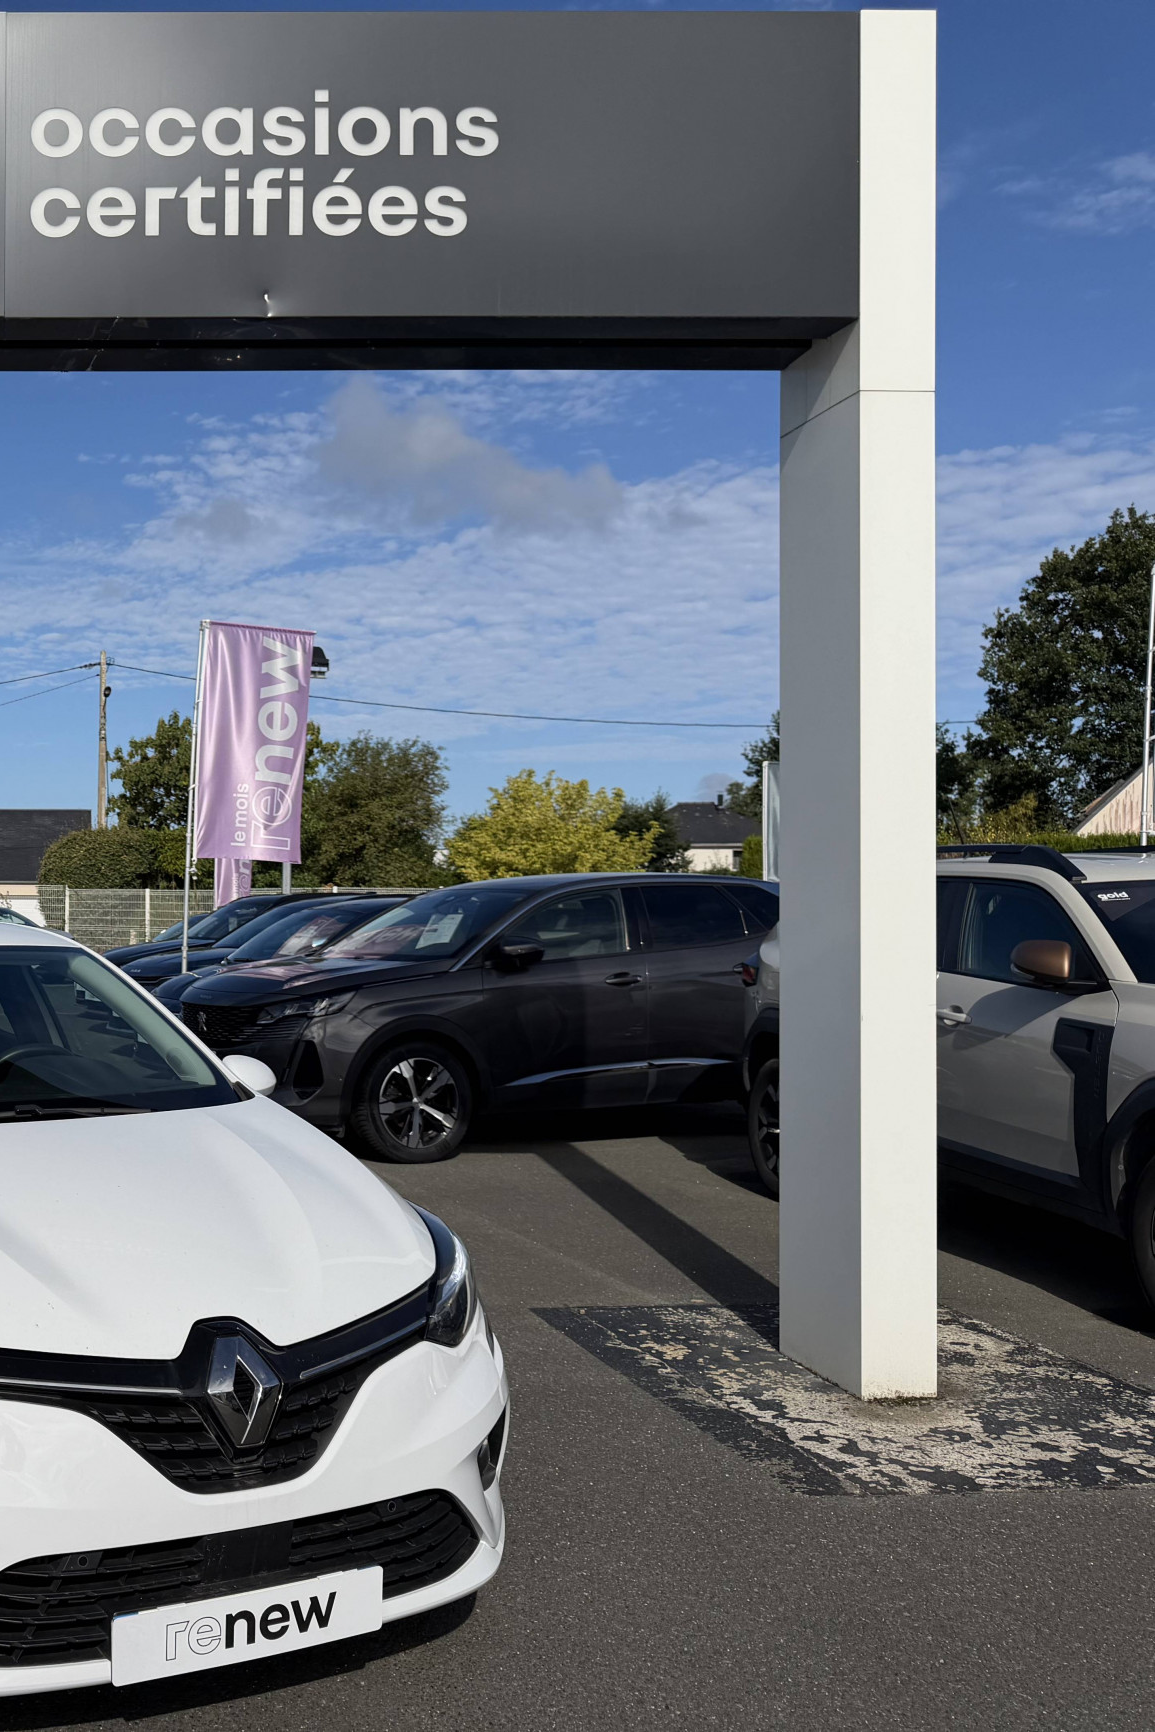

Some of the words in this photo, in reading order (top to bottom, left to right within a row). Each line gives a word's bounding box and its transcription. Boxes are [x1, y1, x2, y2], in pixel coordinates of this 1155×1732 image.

[31, 89, 499, 158] occasions
[30, 168, 468, 238] certifiées
[250, 635, 303, 850] renew
[231, 830, 246, 847] le
[234, 783, 249, 829] mois
[1097, 891, 1129, 901] gold
[166, 1591, 337, 1662] renew
